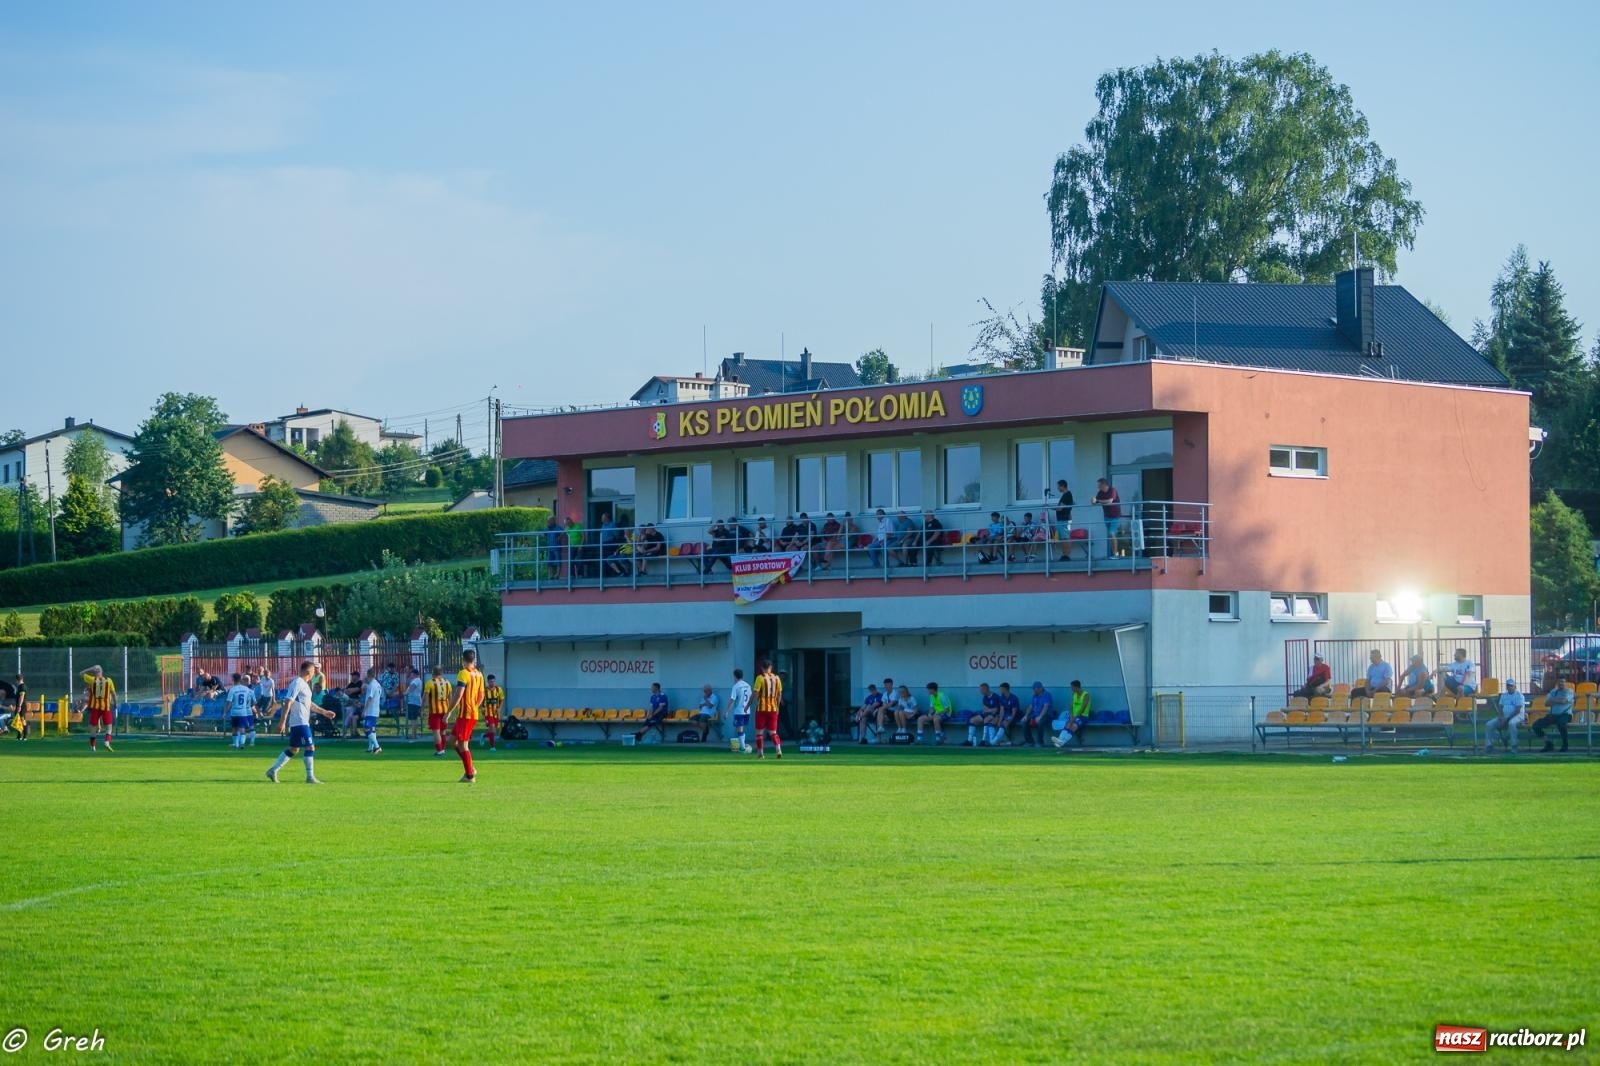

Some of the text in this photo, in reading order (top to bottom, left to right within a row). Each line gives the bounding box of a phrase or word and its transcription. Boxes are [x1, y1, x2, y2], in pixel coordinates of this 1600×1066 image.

[679, 390, 946, 437] KS PŁOMIEŃ POŁOMIA
[734, 560, 786, 573] KLUB SPORTOWY
[580, 660, 655, 674] GOSPODARZE
[969, 651, 1018, 670] GOŚCIE
[238, 693, 245, 705] 6
